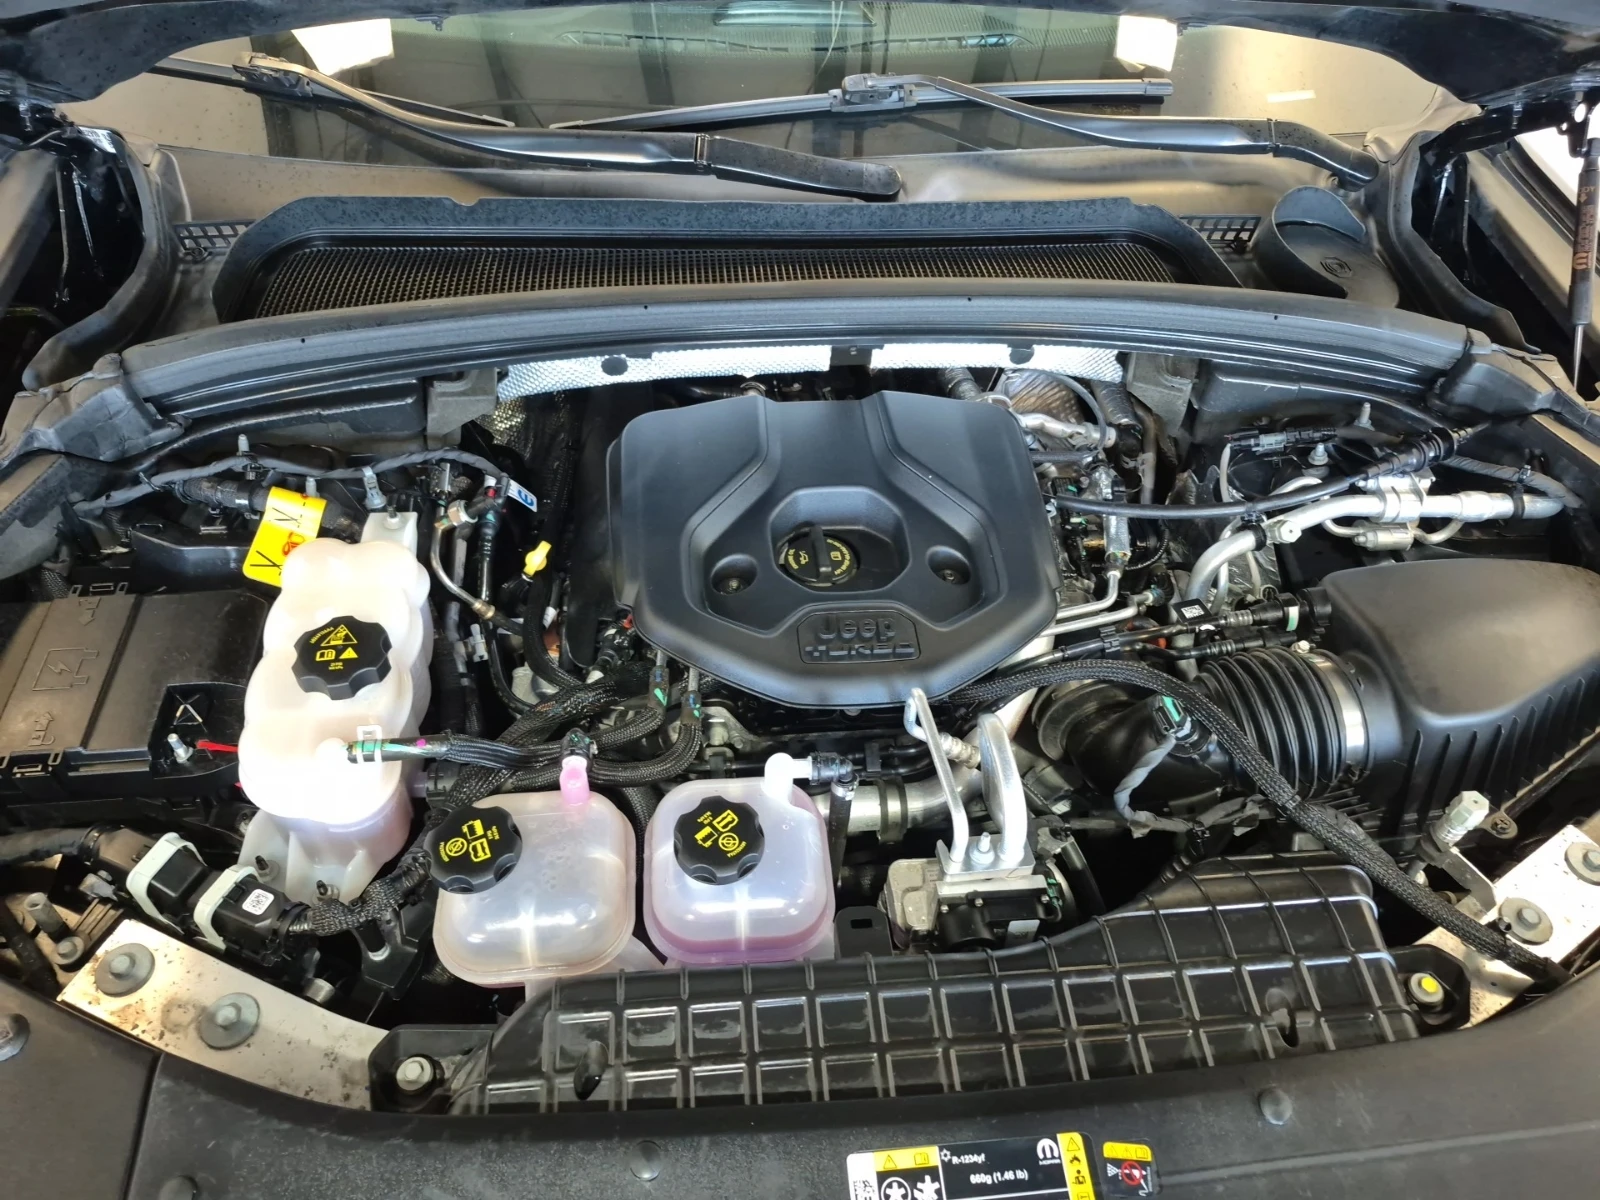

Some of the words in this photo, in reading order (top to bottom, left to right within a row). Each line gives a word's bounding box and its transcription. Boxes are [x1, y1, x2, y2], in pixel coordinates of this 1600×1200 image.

[818, 614, 897, 642] Jeep
[952, 1154, 985, 1166] R-1234yf
[969, 1173, 992, 1185] 660g
[992, 1170, 1014, 1183] (1.46
[1015, 1168, 1029, 1181] lb)
